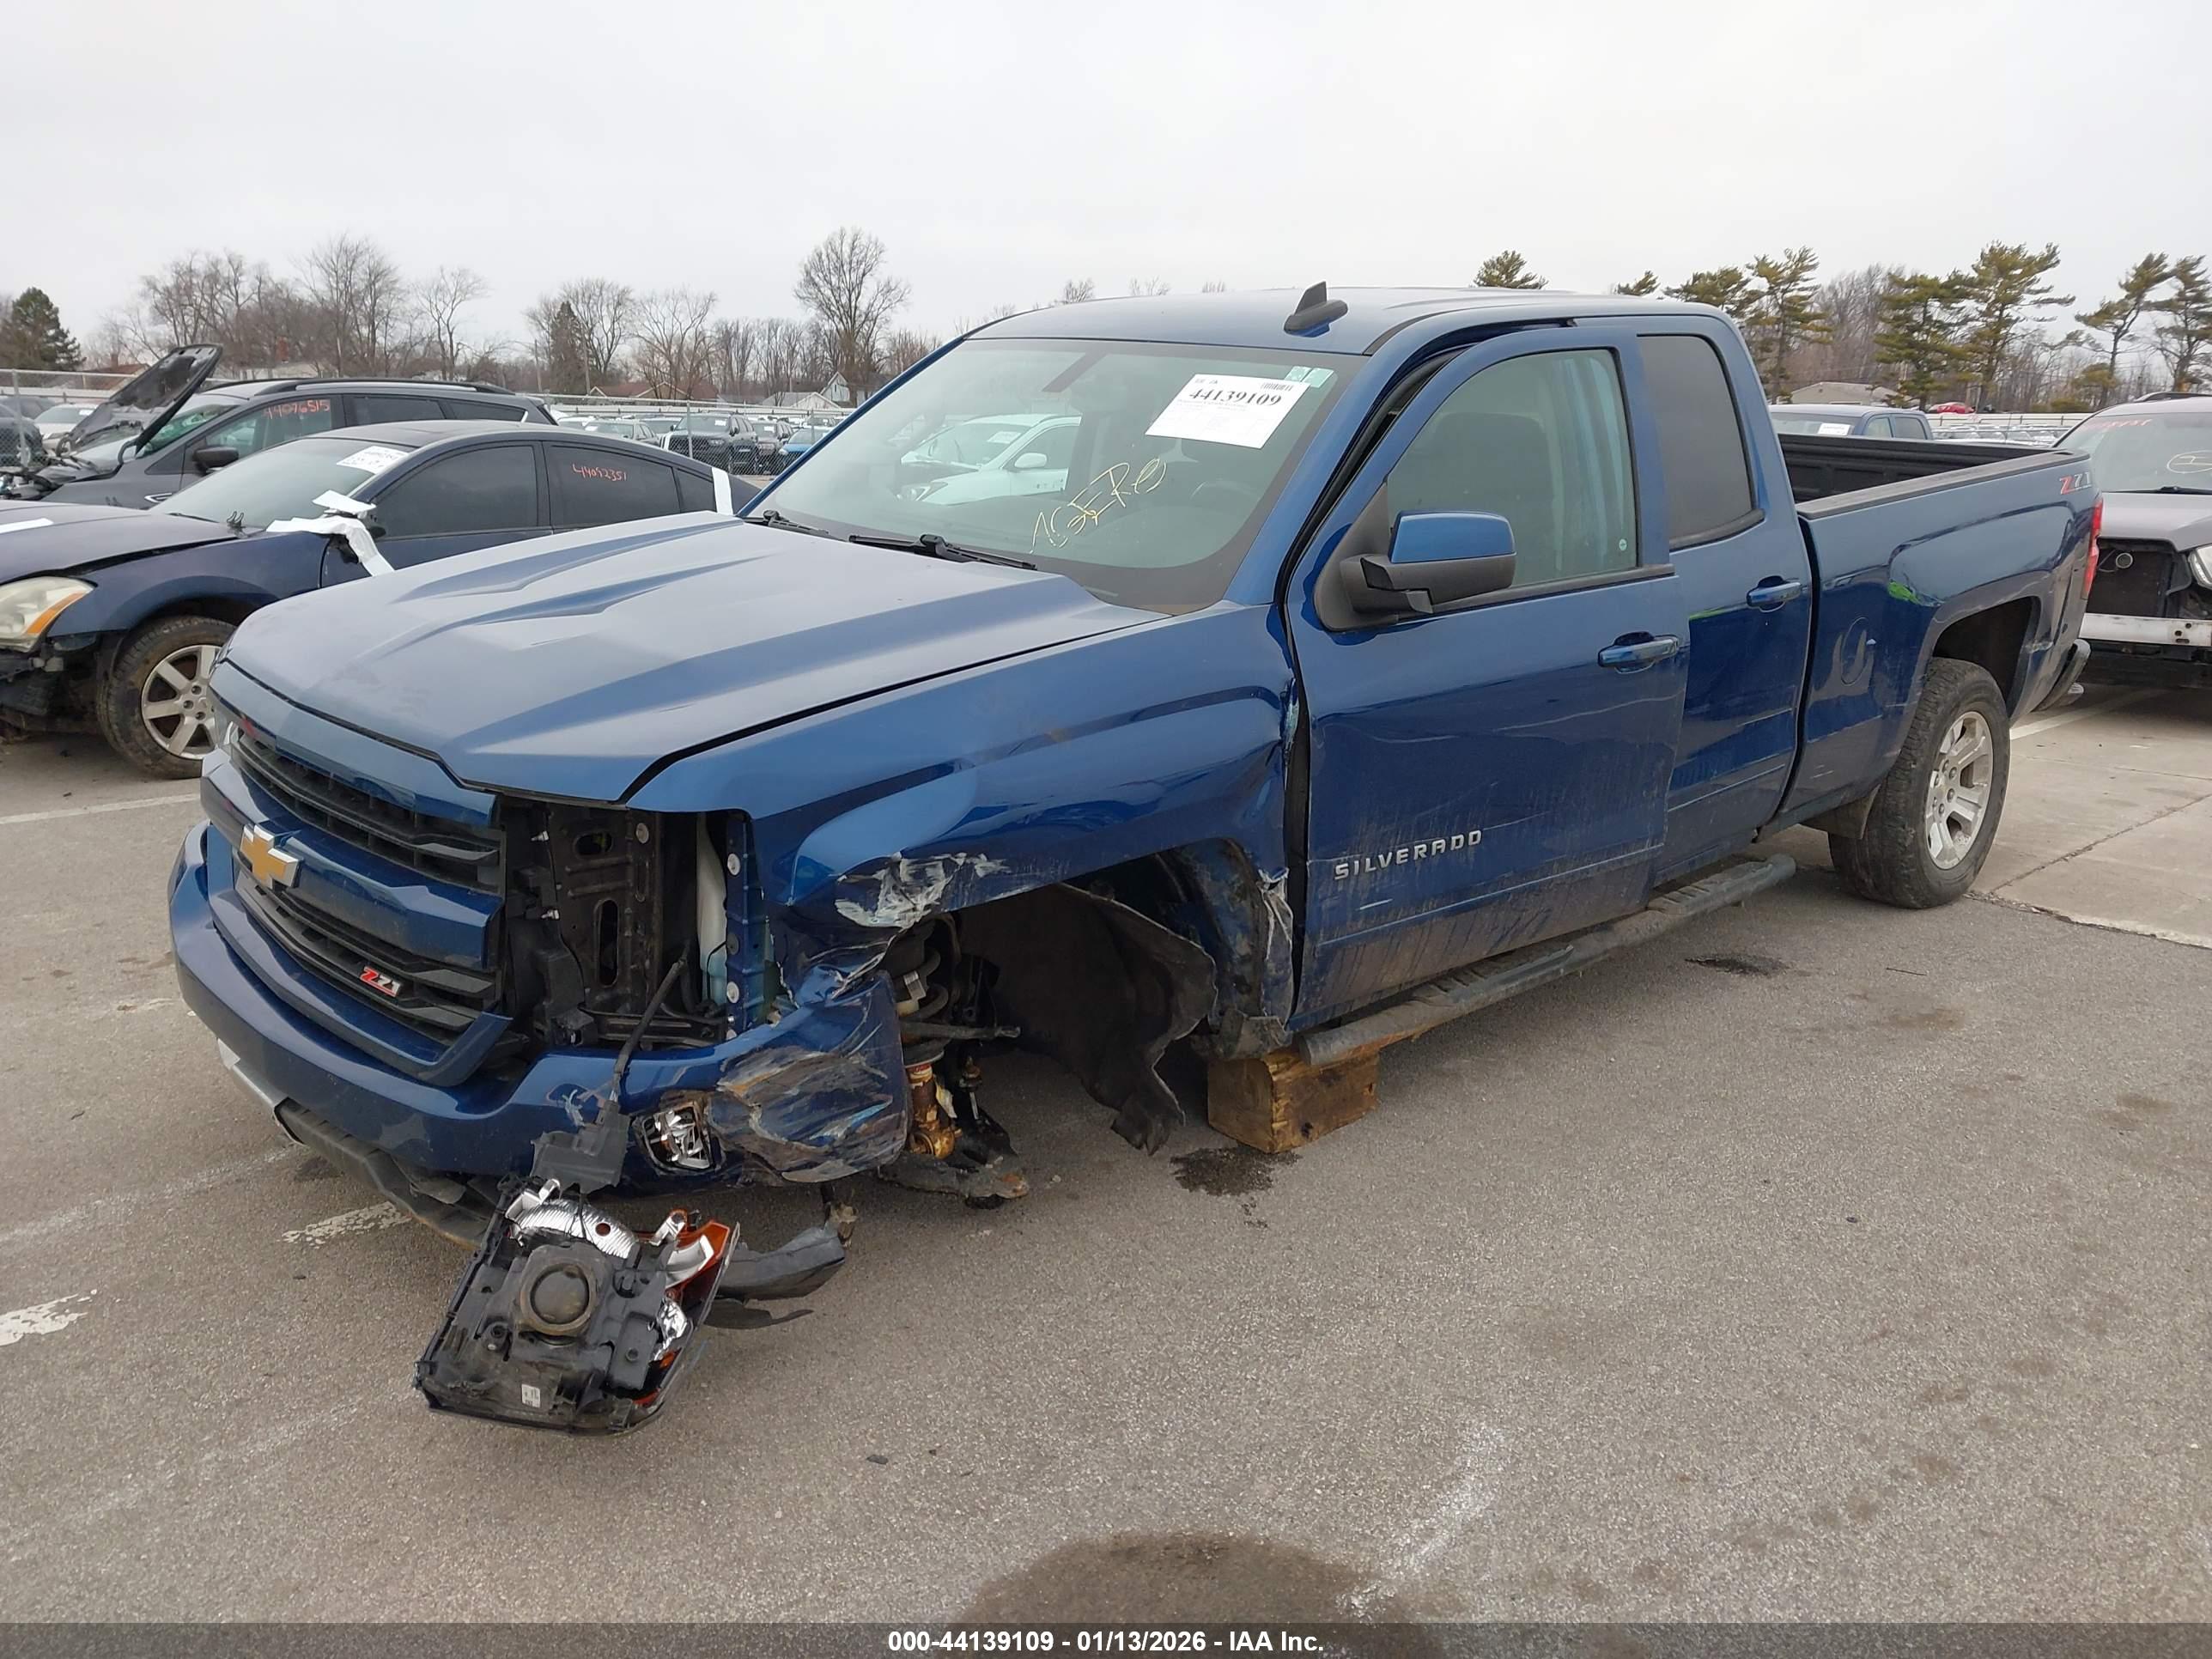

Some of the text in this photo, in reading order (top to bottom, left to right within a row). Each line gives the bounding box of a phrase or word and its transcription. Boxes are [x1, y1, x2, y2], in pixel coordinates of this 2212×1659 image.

[1189, 388, 1281, 406] 44139109
[2060, 471, 2092, 495] Z71
[1334, 830, 1481, 879] SILVERADO
[360, 965, 402, 997] Z71
